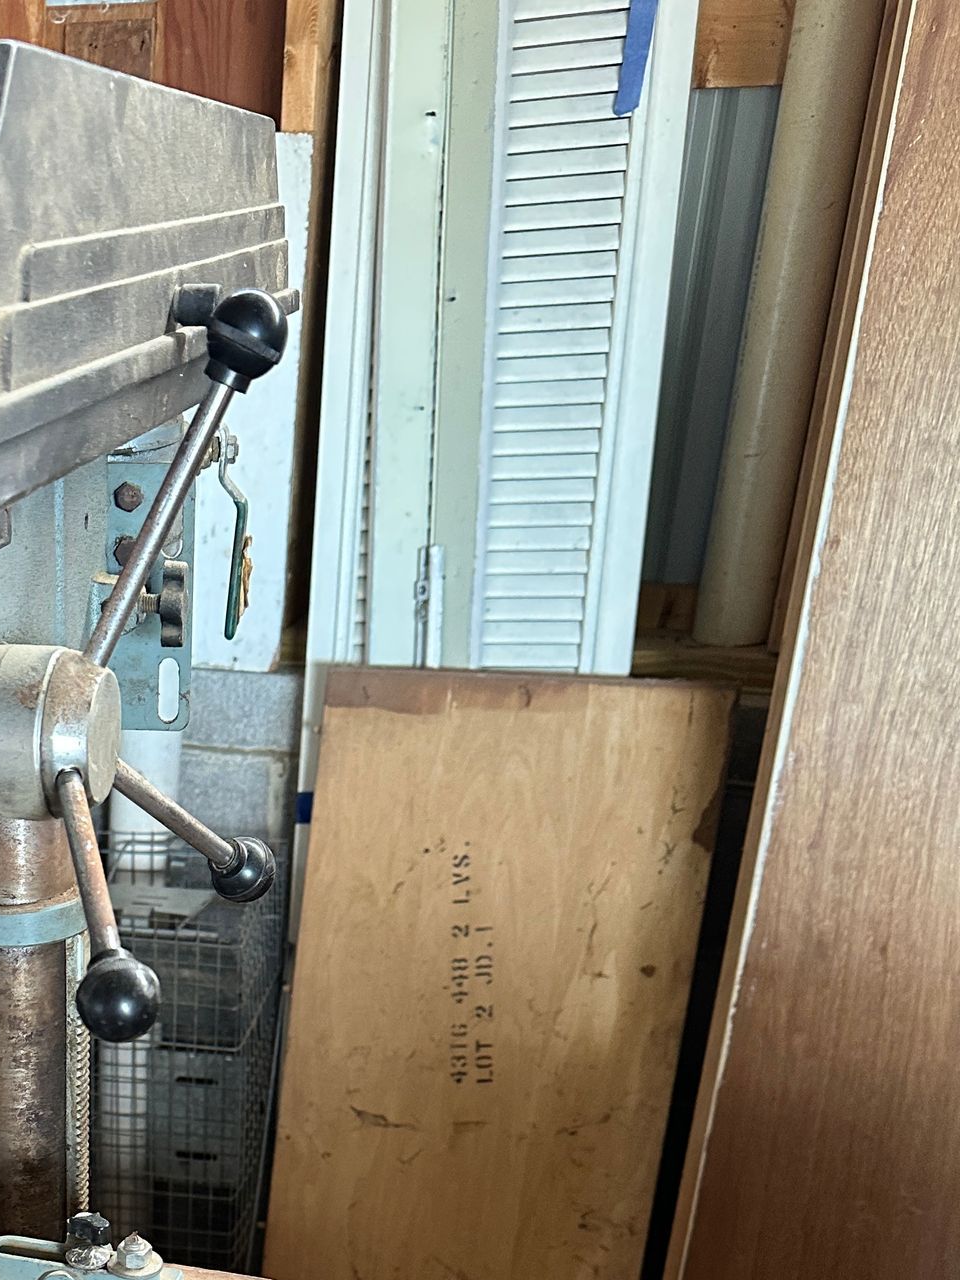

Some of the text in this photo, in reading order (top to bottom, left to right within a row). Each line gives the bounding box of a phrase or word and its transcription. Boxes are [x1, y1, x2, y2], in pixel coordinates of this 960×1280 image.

[451, 924, 470, 938] 2
[451, 957, 469, 1004] 448
[475, 1004, 494, 1019] 2
[475, 1040, 494, 1084] LOT
